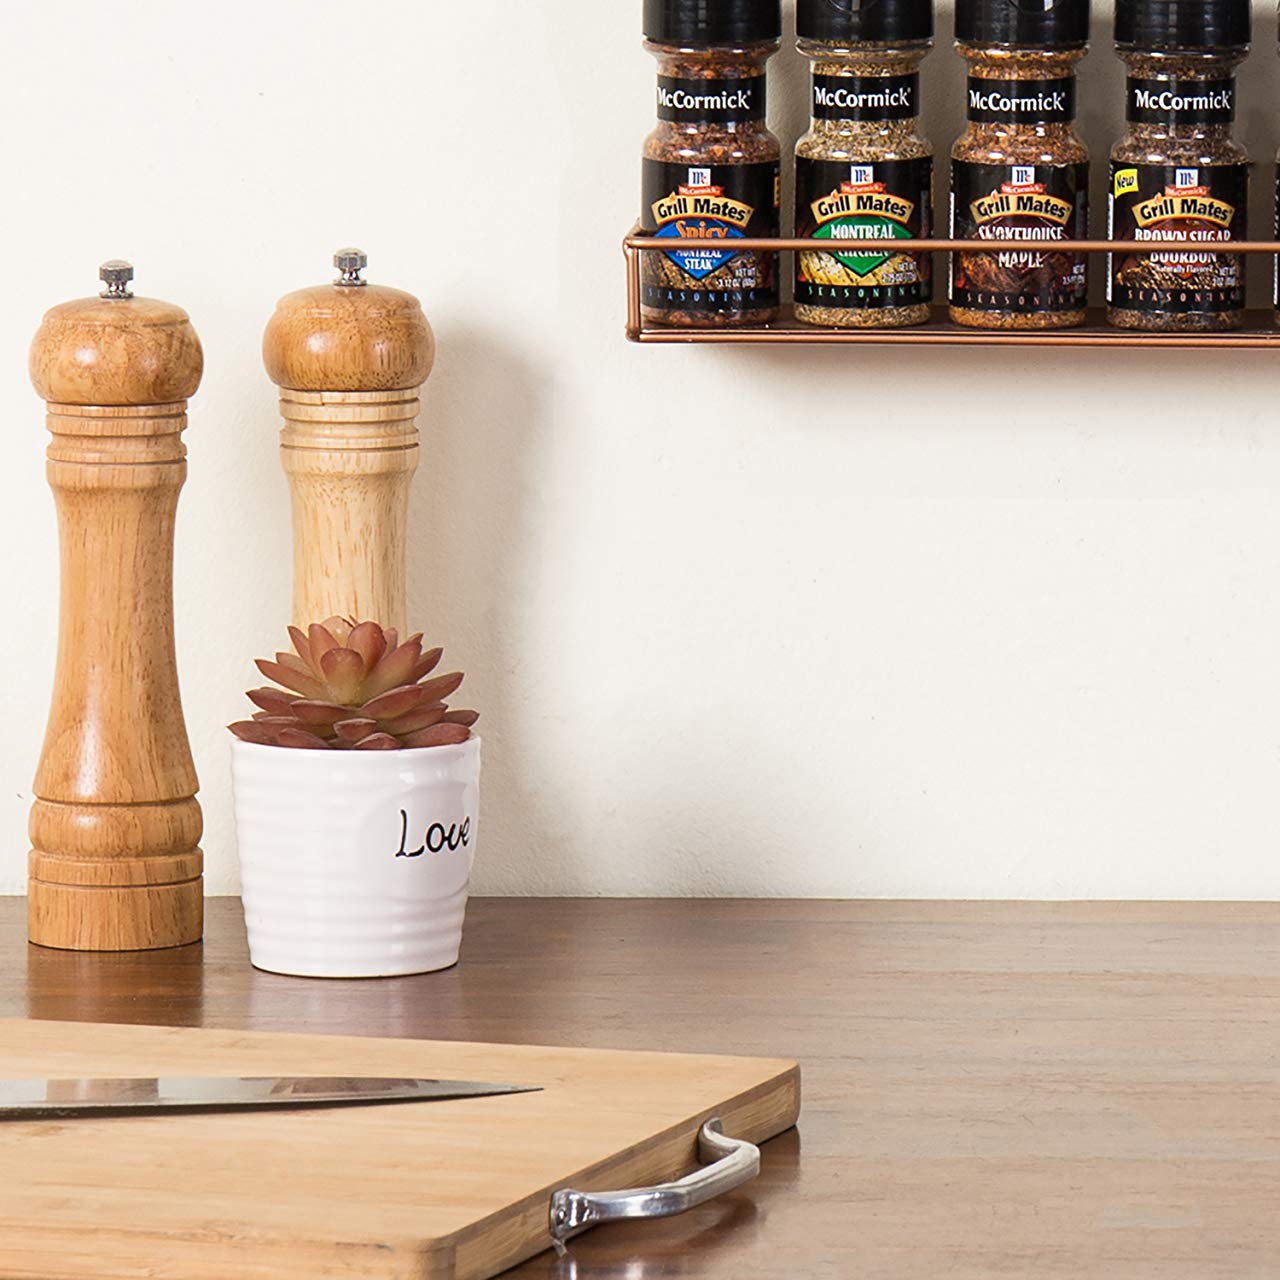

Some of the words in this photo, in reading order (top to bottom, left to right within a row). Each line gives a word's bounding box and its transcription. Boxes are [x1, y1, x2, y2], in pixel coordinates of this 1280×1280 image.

[657, 86, 749, 110] McCormick
[814, 86, 910, 108] McCormick
[969, 89, 1064, 111] McCormick
[1134, 89, 1231, 111] McCormick
[1117, 174, 1134, 189] New
[657, 197, 689, 218] Grill
[694, 198, 746, 221] Mates
[818, 195, 850, 217] Grill
[857, 195, 907, 217] Mates
[976, 195, 1011, 217] Grill
[1016, 195, 1067, 218] Mates
[1140, 199, 1174, 220] Grill
[1180, 199, 1230, 220] Mates
[675, 220, 729, 238] Spicy
[830, 223, 896, 239] MONTREAL
[1134, 228, 1187, 241] BROWN
[1190, 230, 1231, 241] SUGAR
[684, 258, 713, 271] STEAK
[998, 251, 1045, 269] MAPLE
[808, 286, 917, 298] SEASONING
[395, 808, 470, 858] Love
